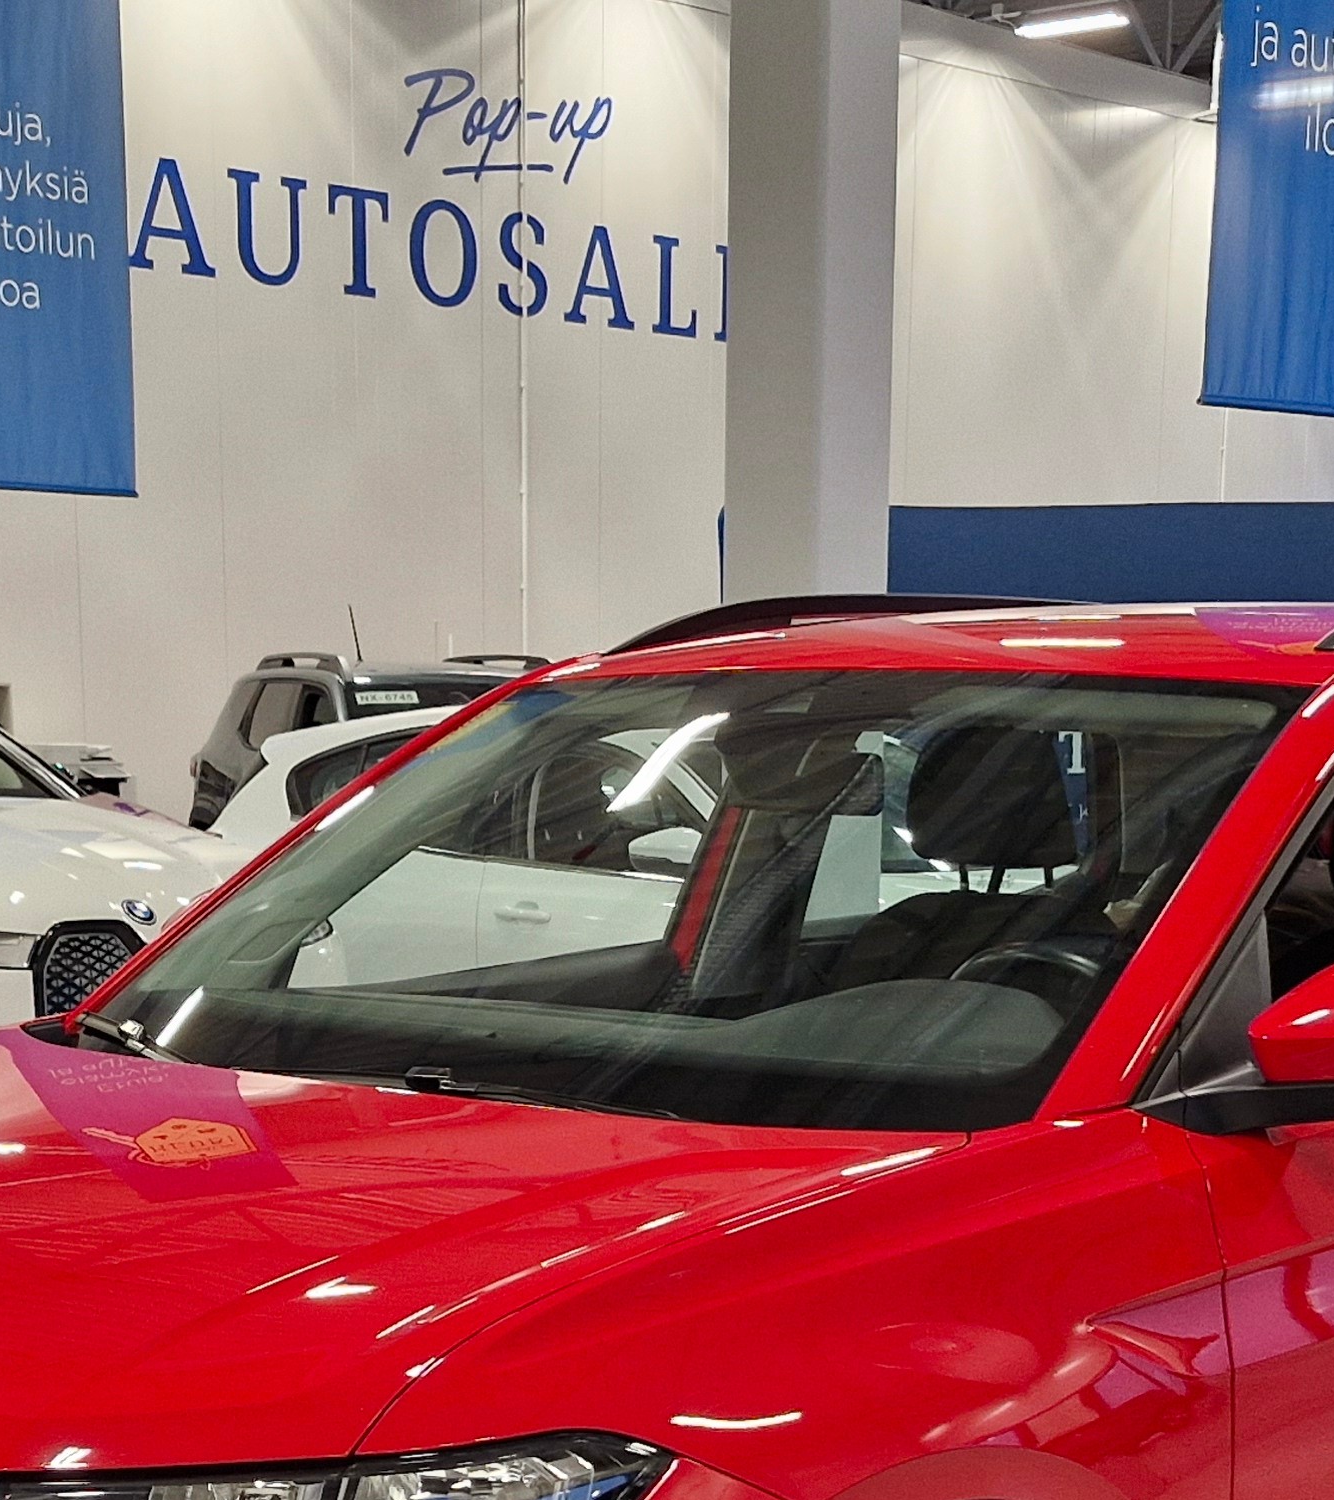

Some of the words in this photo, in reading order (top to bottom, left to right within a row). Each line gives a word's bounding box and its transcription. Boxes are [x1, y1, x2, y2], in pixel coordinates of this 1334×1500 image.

[1250, 4, 1280, 67] ja
[403, 67, 613, 185] Pop-up
[129, 157, 729, 342] AUTOSAL
